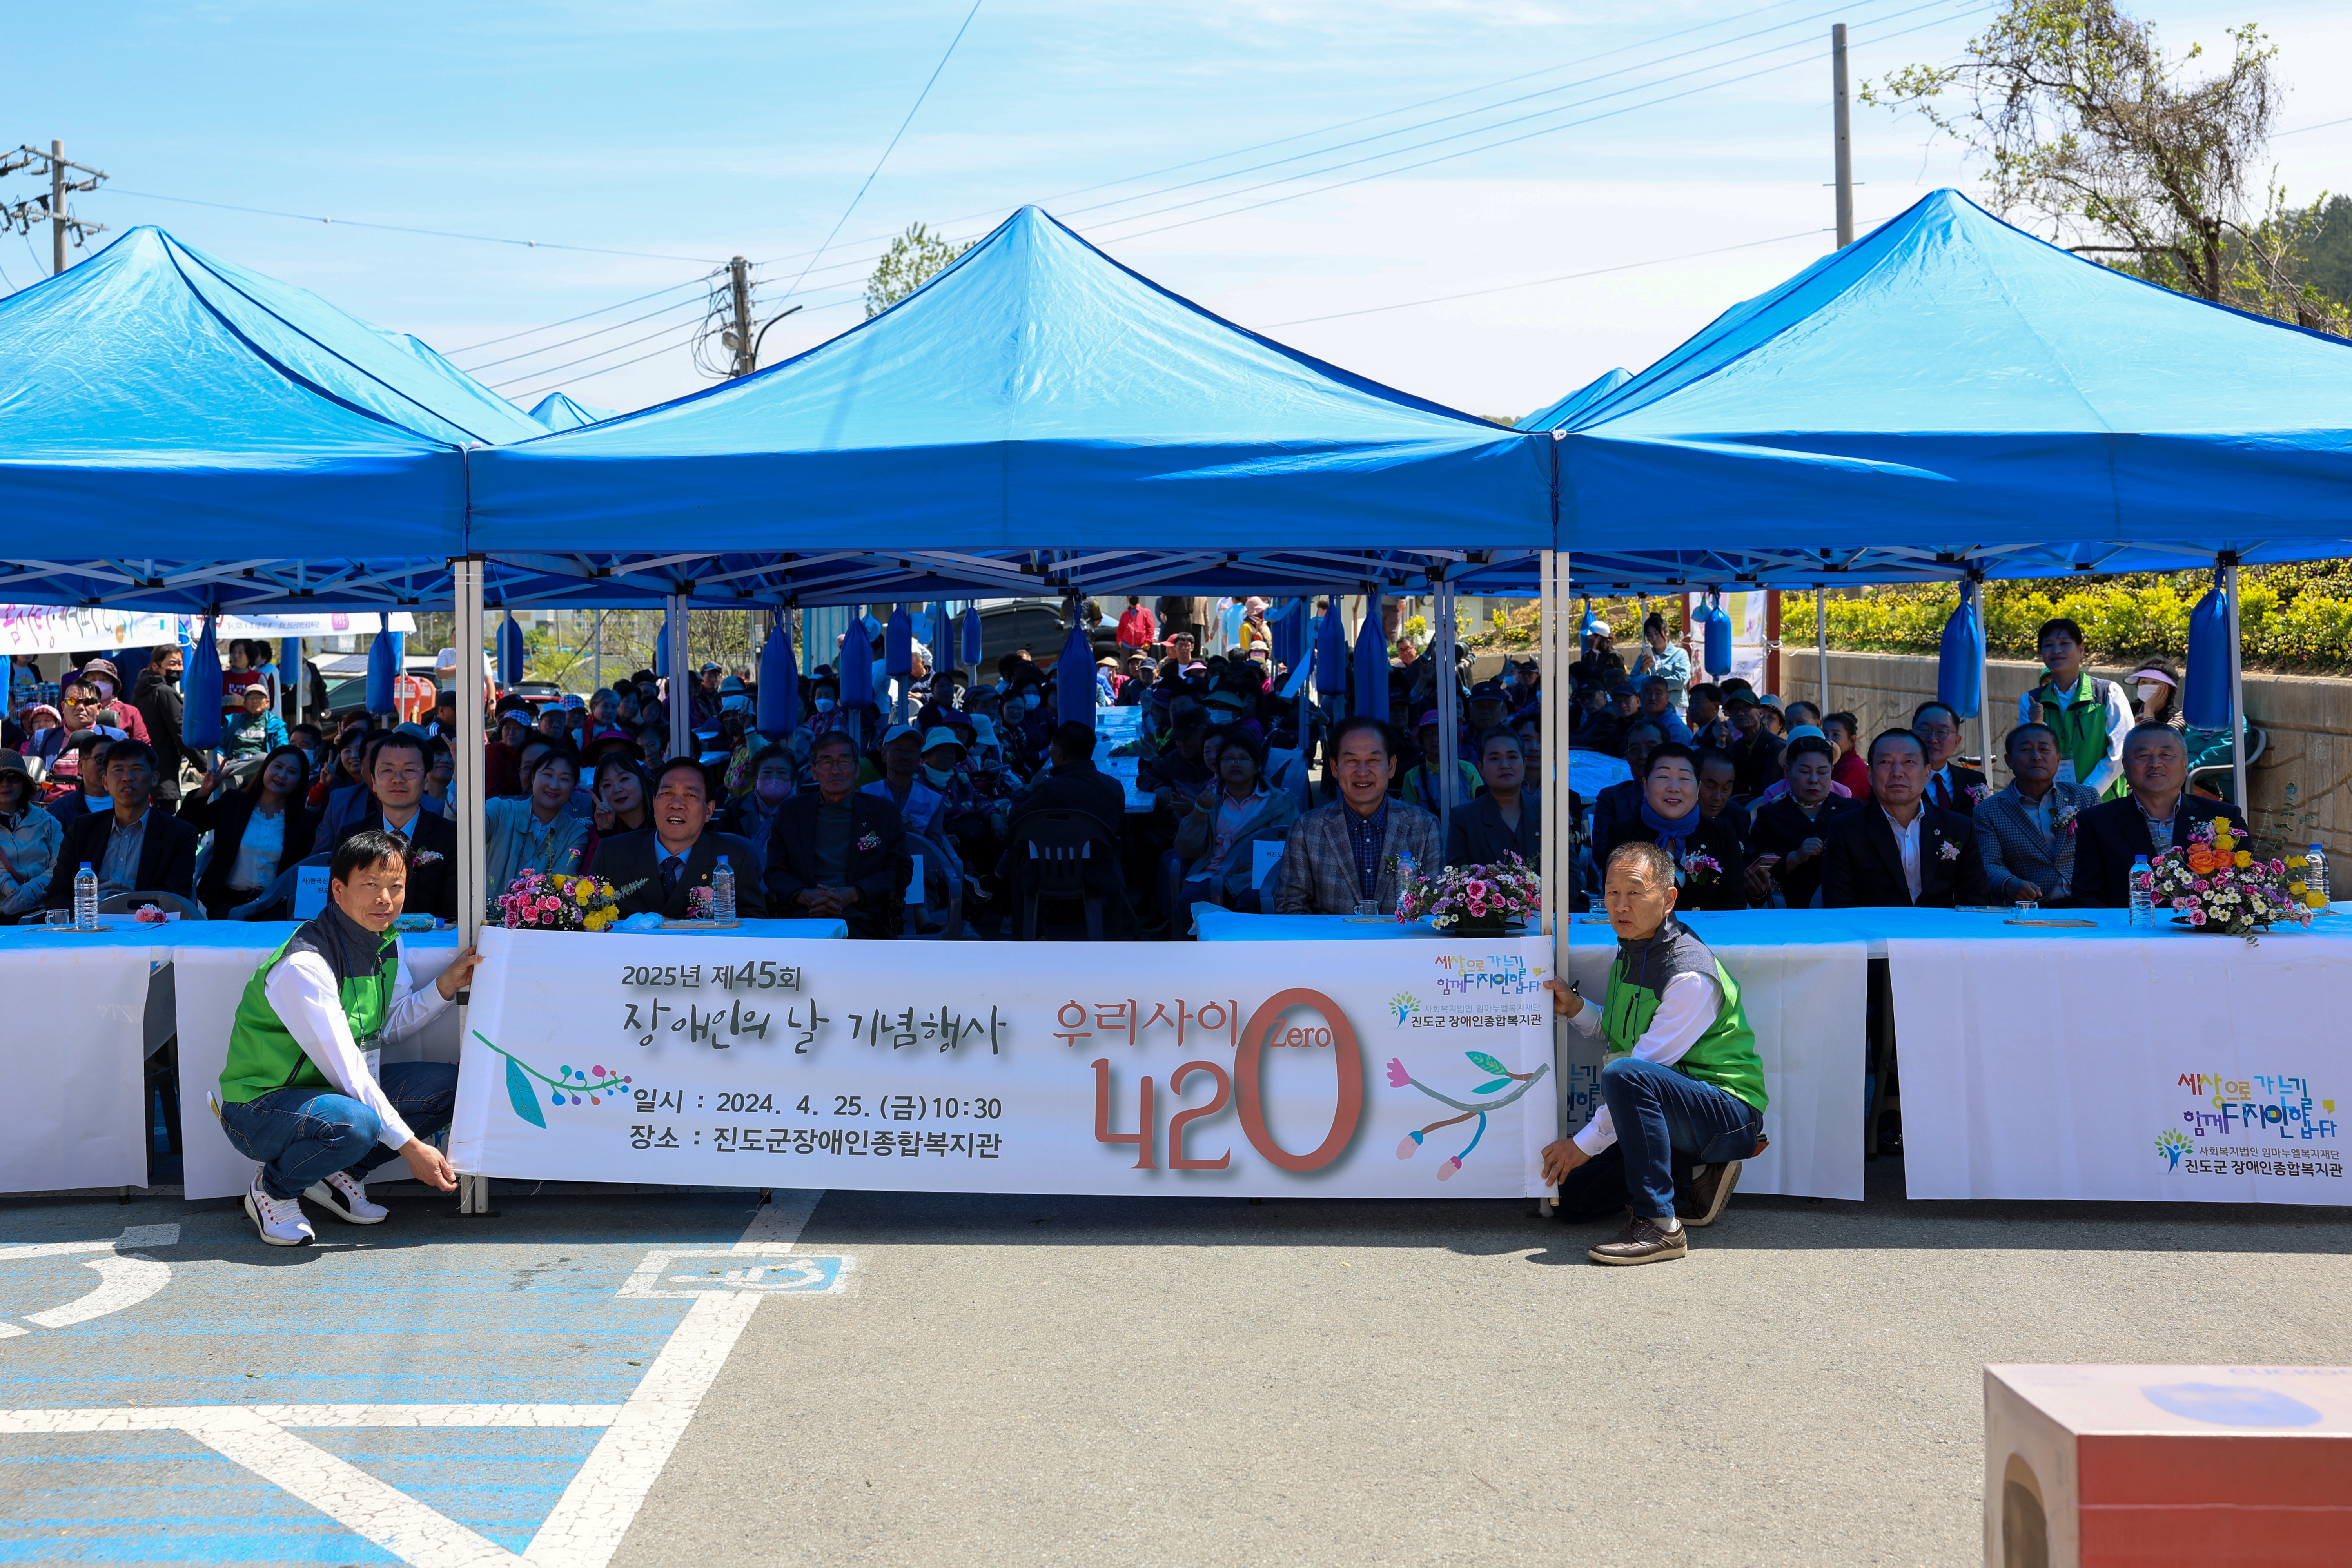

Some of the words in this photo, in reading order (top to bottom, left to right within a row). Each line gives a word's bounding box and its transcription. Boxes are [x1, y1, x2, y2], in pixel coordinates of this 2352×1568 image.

[621, 964, 701, 988] 2025년
[711, 960, 801, 992] 제45회
[1434, 955, 1485, 977] 세상으로
[1411, 1015, 1446, 1028] 진도군
[1448, 1014, 1542, 1028] 장애인종합복지관
[1424, 1004, 1473, 1014] 사회복지법인
[1476, 1003, 1541, 1013] 임마누엘복지재단
[623, 997, 771, 1050] 장애인의
[788, 998, 830, 1054] 날
[848, 1005, 1007, 1055] 기념행사
[1052, 998, 1238, 1048] 우리사이
[1268, 1021, 1332, 1048] Zero
[633, 1089, 683, 1114] 일시
[717, 1093, 780, 1114] 2024.
[796, 1095, 818, 1115] 4.
[2177, 1072, 2252, 1109] 세상으로
[629, 1125, 680, 1150] 장소
[713, 1127, 1003, 1159] 진도군장애인종합복지관
[2199, 1146, 2259, 1158] 사회복지법인
[2262, 1147, 2340, 1160] 임마누엘복지재단
[2185, 1159, 2227, 1175] 진도군
[2230, 1160, 2343, 1178] 장애인종합복지관
